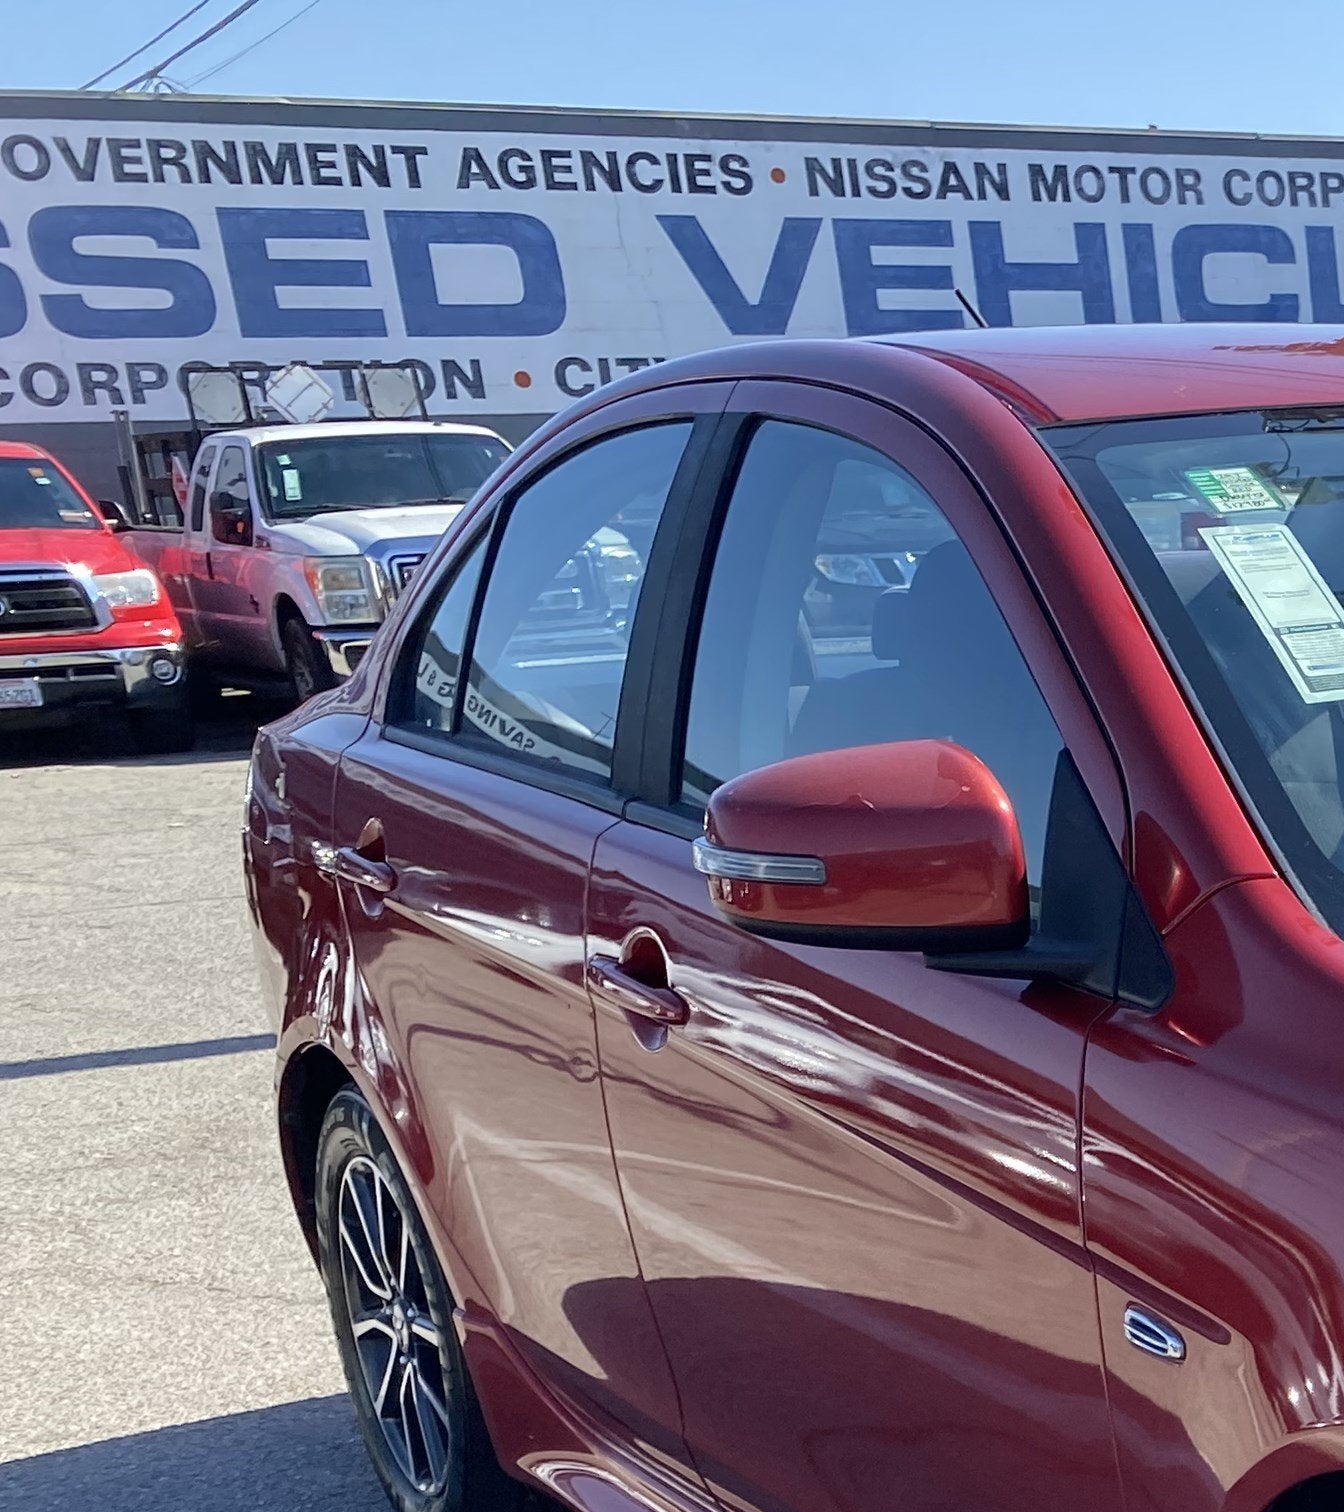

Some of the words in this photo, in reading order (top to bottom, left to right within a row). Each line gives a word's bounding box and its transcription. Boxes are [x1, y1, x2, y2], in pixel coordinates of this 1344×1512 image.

[456, 146, 754, 196] AGENCIES
[804, 156, 1011, 202] NISSAN
[1028, 163, 1206, 206] MOTOR
[0, 204, 567, 340] SED
